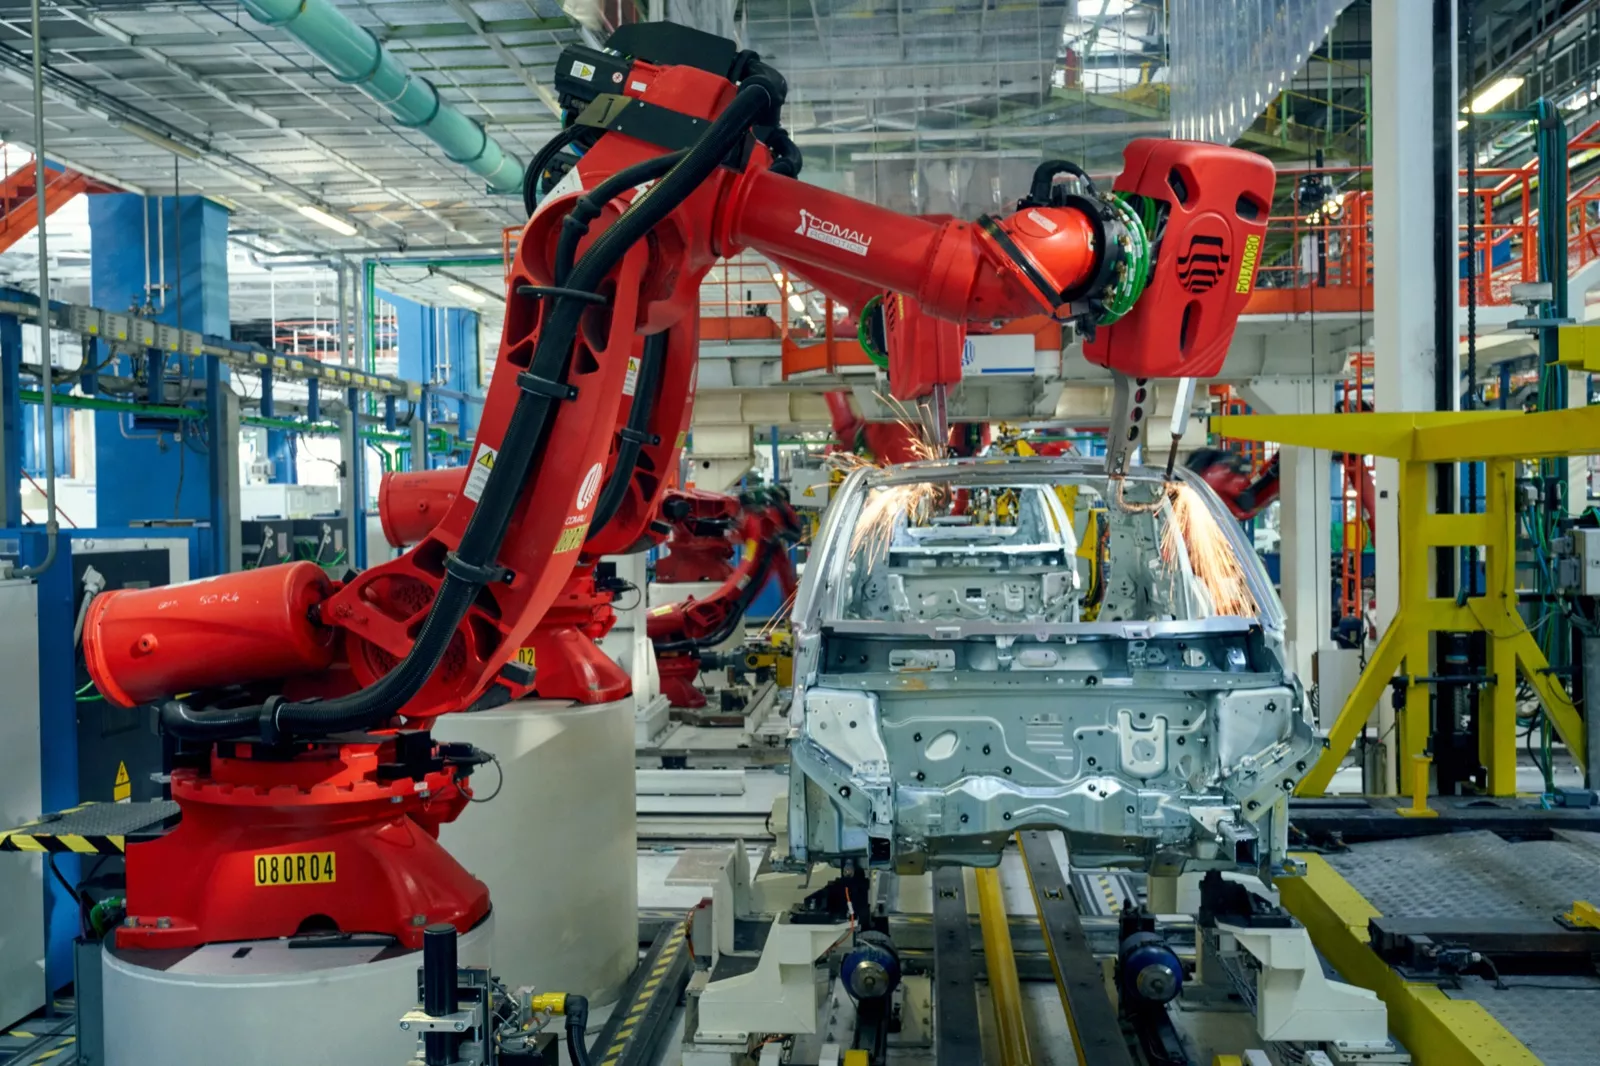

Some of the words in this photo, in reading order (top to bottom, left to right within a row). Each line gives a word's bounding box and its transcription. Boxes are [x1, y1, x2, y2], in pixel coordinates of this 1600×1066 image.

[809, 217, 872, 246] COMAU
[1237, 236, 1260, 292] 080W104
[257, 854, 334, 884] 080R04
